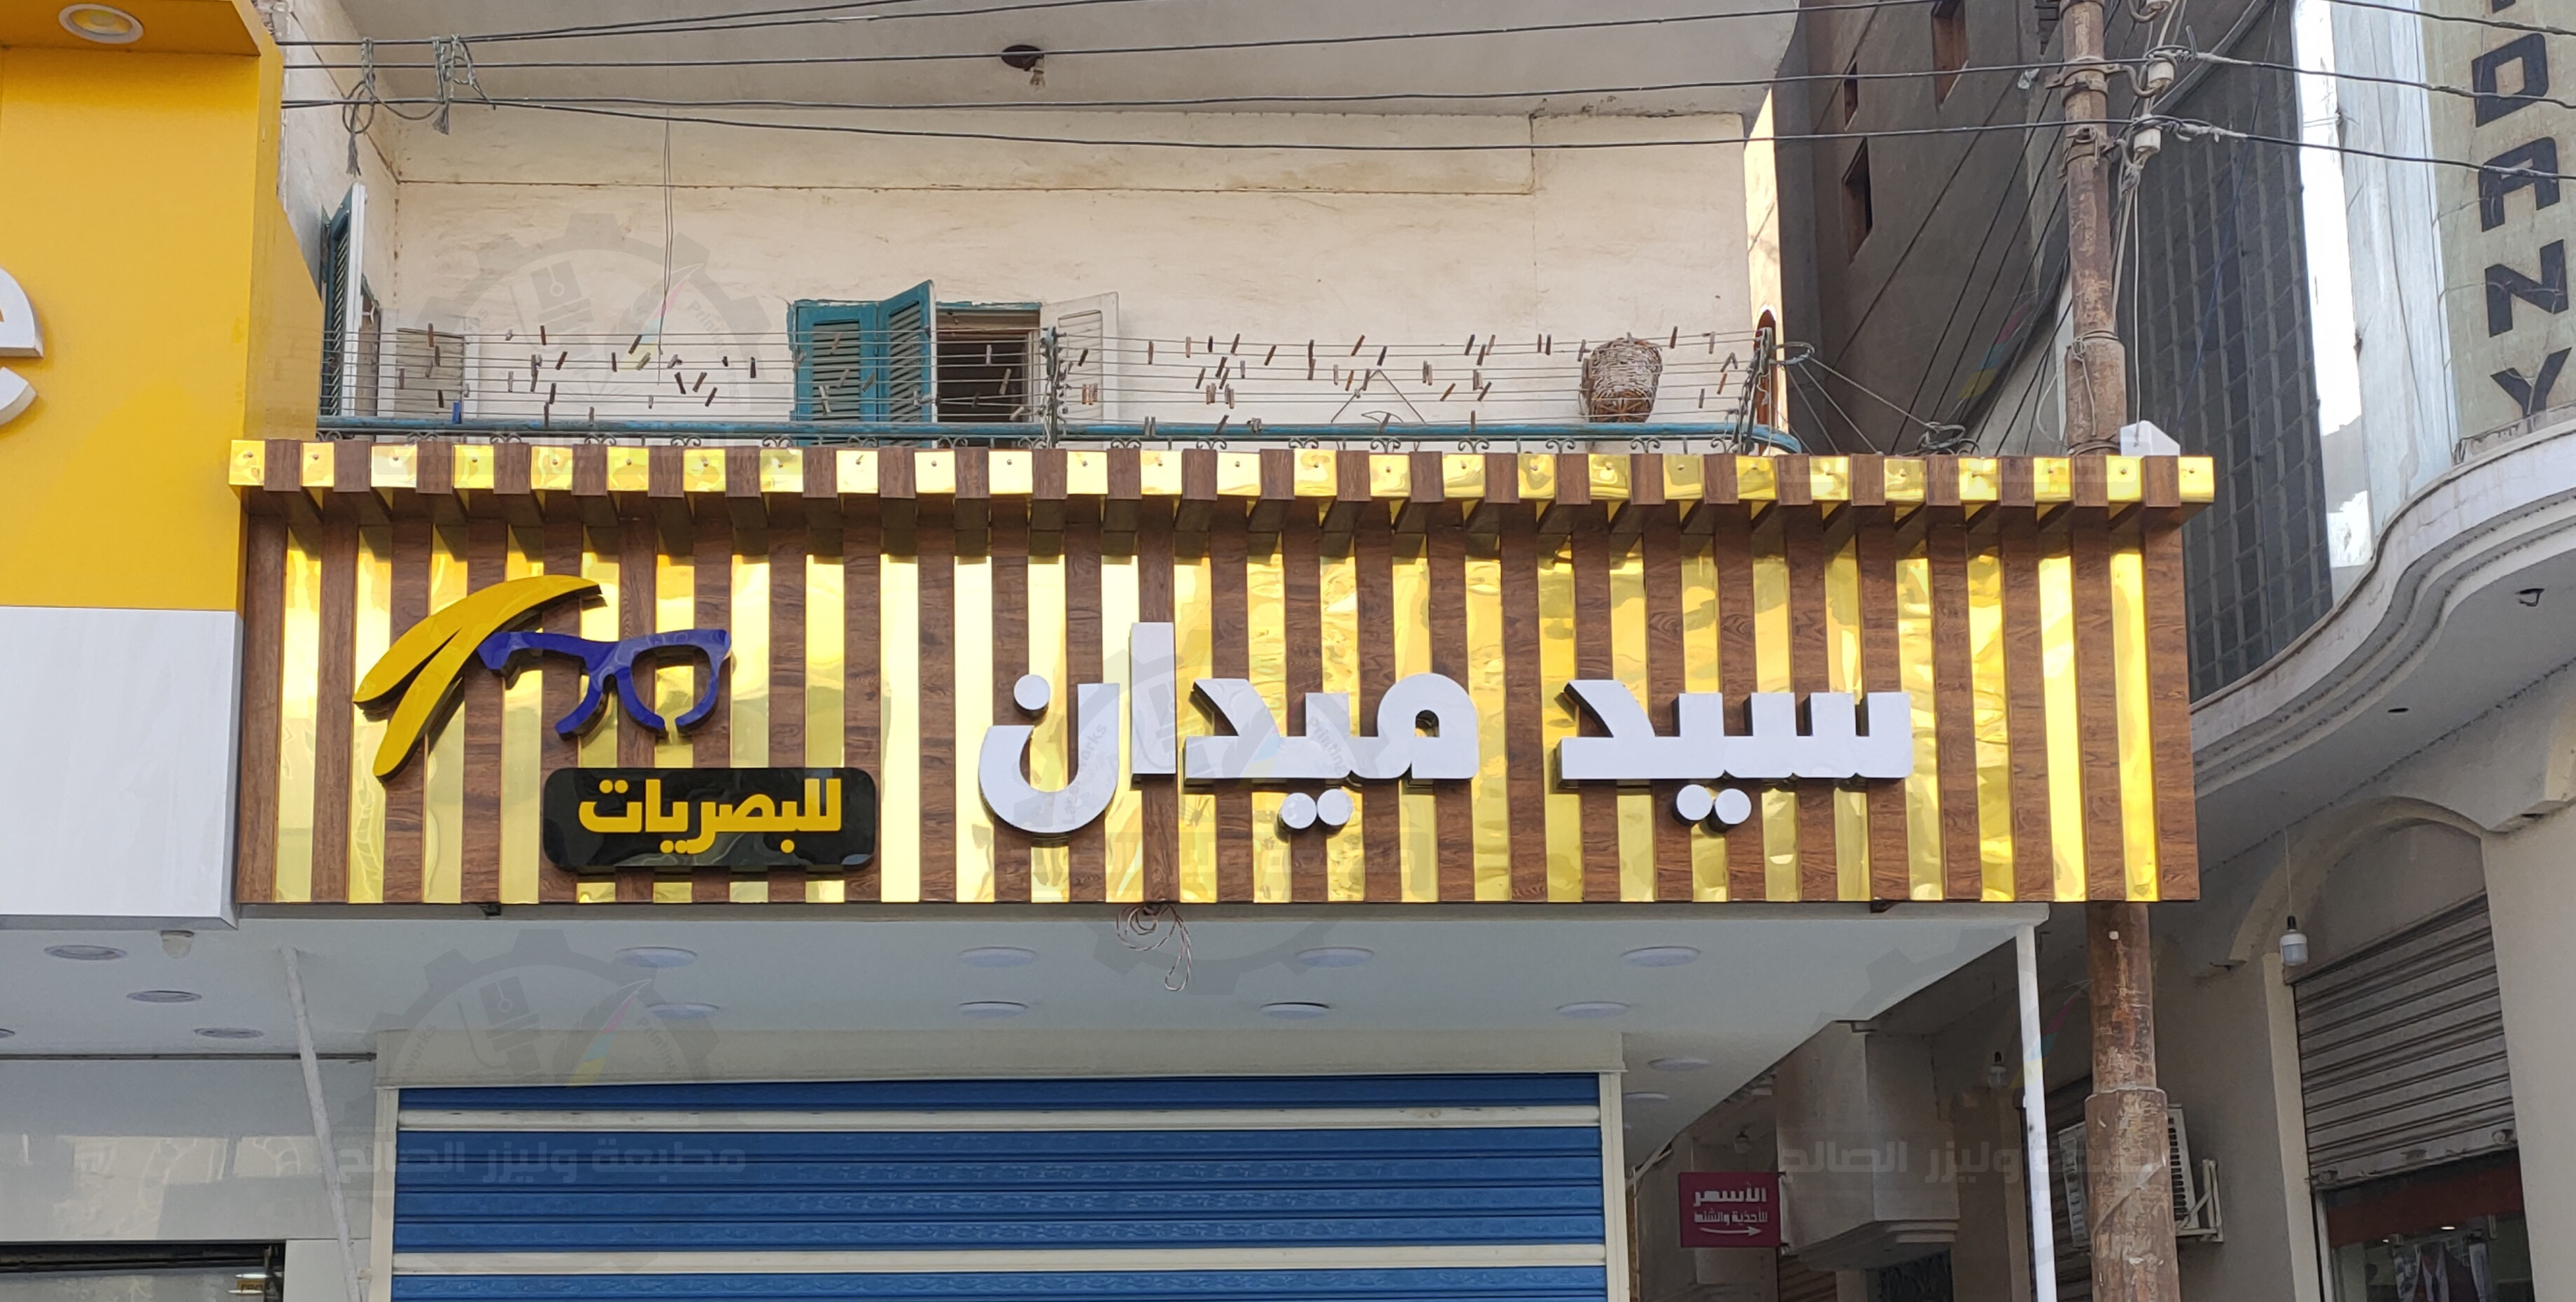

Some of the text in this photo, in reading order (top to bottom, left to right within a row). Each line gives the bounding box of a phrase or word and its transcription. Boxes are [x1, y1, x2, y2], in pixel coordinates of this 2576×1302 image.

[2471, 0, 2572, 418] DANY
[578, 778, 842, 854] للبصريات
[979, 622, 1913, 833] سيد ميدان
